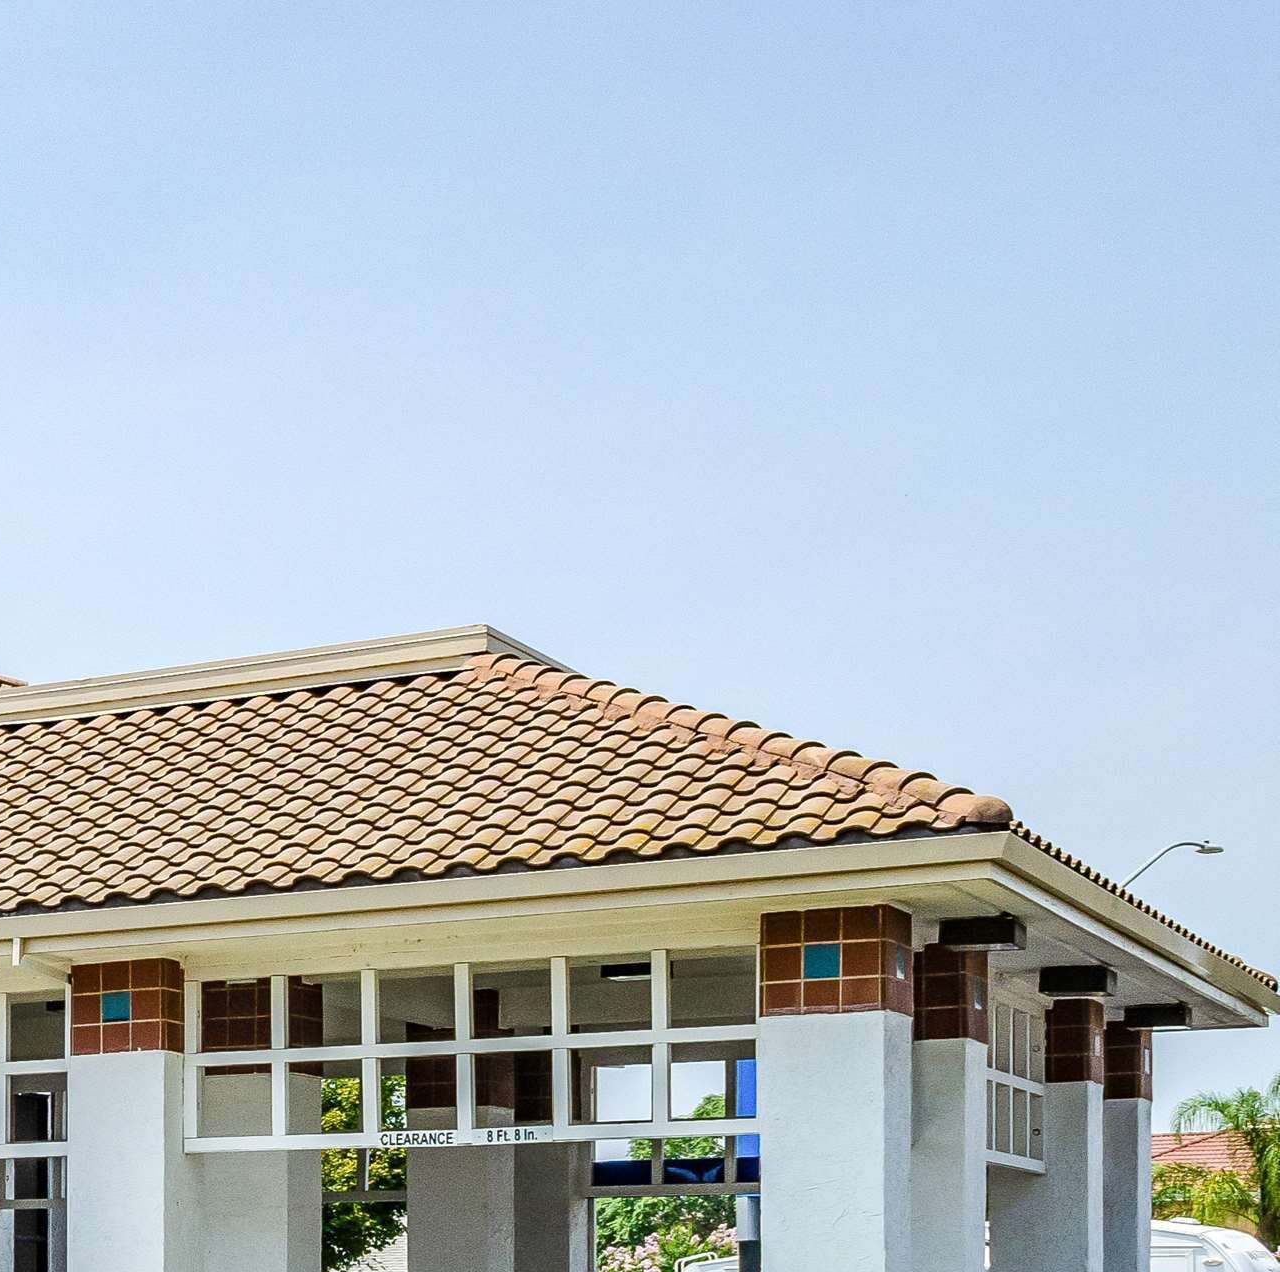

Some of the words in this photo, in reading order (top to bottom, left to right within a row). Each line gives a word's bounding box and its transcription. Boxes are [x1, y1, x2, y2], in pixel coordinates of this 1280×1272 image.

[380, 1132, 454, 1146] CLEARANCE
[486, 1130, 493, 1142] 8
[496, 1129, 511, 1142] Ft.
[514, 1128, 521, 1141] 8
[524, 1128, 538, 1141] In.
